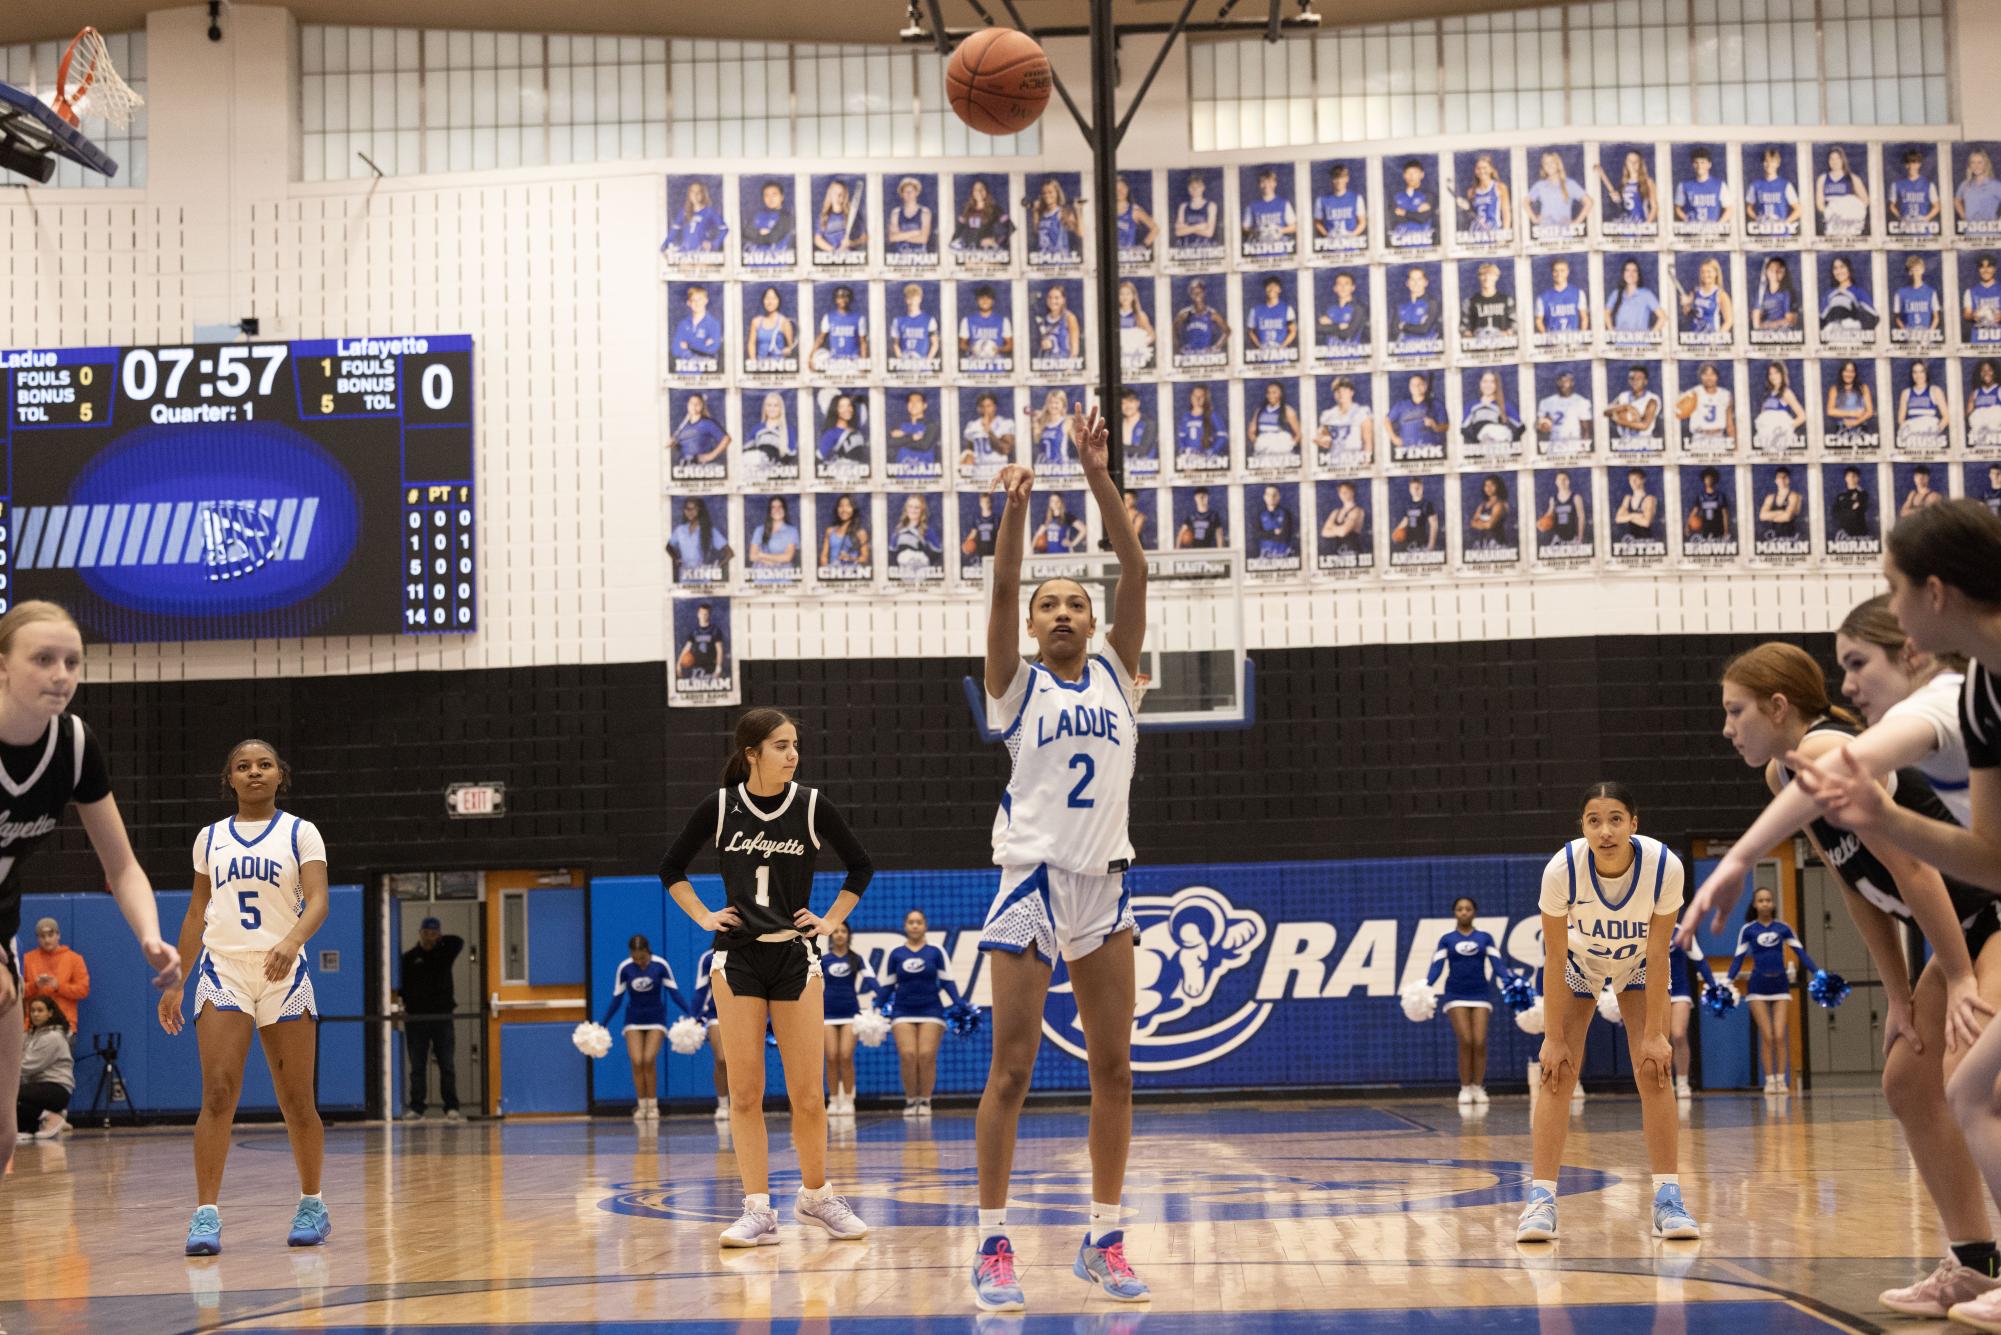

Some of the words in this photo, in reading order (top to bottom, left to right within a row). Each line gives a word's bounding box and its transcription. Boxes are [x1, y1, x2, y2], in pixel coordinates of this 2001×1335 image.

[1748, 221, 1799, 235] CODY
[1028, 252, 1080, 265] SMALL
[337, 337, 429, 360] Lafayette
[122, 345, 288, 401] 07:57
[321, 357, 331, 377] 1
[341, 359, 394, 375] FOULS
[676, 358, 718, 372] KEYS
[745, 357, 797, 371] SUNG
[17, 370, 70, 387] FOULS
[80, 366, 93, 385] 0
[337, 377, 395, 393] BONUS
[17, 388, 75, 404] BONUS
[421, 363, 454, 410] 0
[17, 406, 49, 421] TOL
[80, 402, 93, 421] 5
[150, 403, 237, 424] Quarter:
[243, 402, 253, 421] 1
[320, 394, 334, 413] 5
[363, 394, 396, 410] TOL
[1703, 405, 1717, 422] 3
[1394, 444, 1443, 461] FINK
[673, 464, 725, 480] CROSS
[428, 486, 451, 503] PT
[409, 511, 421, 529] 0
[434, 510, 446, 527] 0
[459, 509, 471, 526] 0
[410, 534, 419, 551] 1
[434, 533, 446, 551] 0
[460, 532, 470, 550] 1
[1685, 542, 1737, 555] BROWN
[1828, 540, 1879, 554] MORAN
[409, 558, 421, 576] 5
[435, 557, 447, 575] 0
[459, 557, 471, 574] 0
[818, 566, 873, 580] CHEN
[406, 583, 424, 600] 11
[433, 583, 445, 600] 0
[458, 582, 470, 599] 0
[406, 608, 426, 625] 14
[434, 607, 446, 624] 0
[458, 606, 470, 623] 0
[1037, 704, 1120, 748] LADUE
[1067, 753, 1095, 808] 2
[463, 790, 488, 811] EXIT
[724, 830, 805, 859] Lafayette
[215, 856, 282, 889] LADUE
[755, 865, 769, 908] 1
[238, 891, 261, 930] 5
[1577, 919, 1648, 940] LADUE
[1587, 943, 1638, 961] 20
